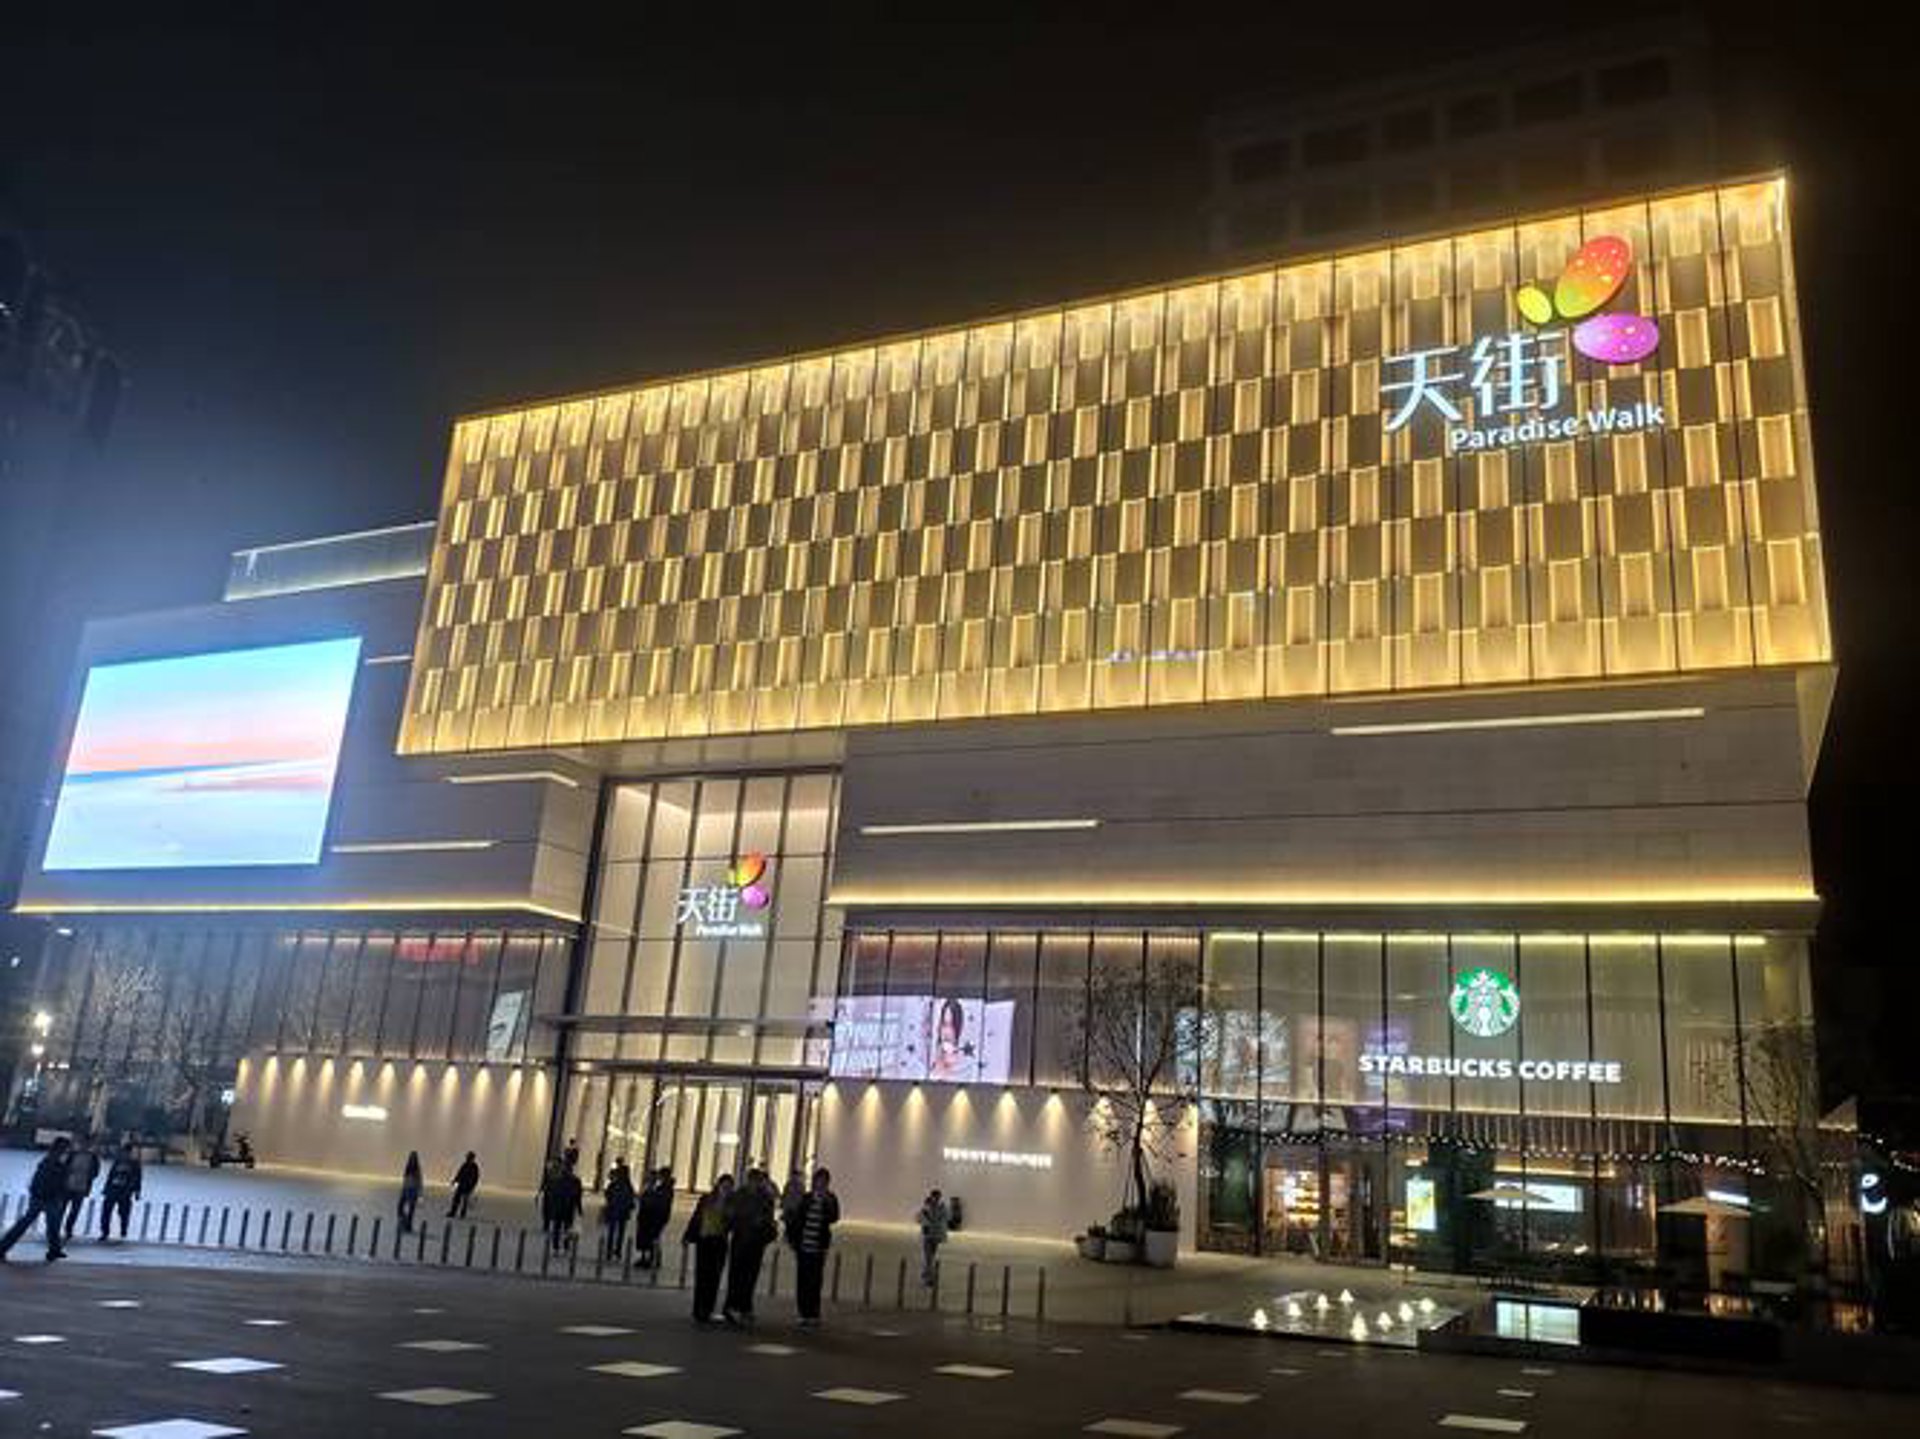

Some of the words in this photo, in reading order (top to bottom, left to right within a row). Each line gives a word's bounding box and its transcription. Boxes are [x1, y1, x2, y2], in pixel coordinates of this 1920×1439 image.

[1379, 332, 1566, 432] 天街
[1450, 416, 1578, 451] Paradise
[1586, 402, 1665, 432] Walk
[678, 886, 738, 922] 天街
[1358, 1054, 1512, 1078] STARBUCKS
[1518, 1060, 1622, 1083] COFFEE
